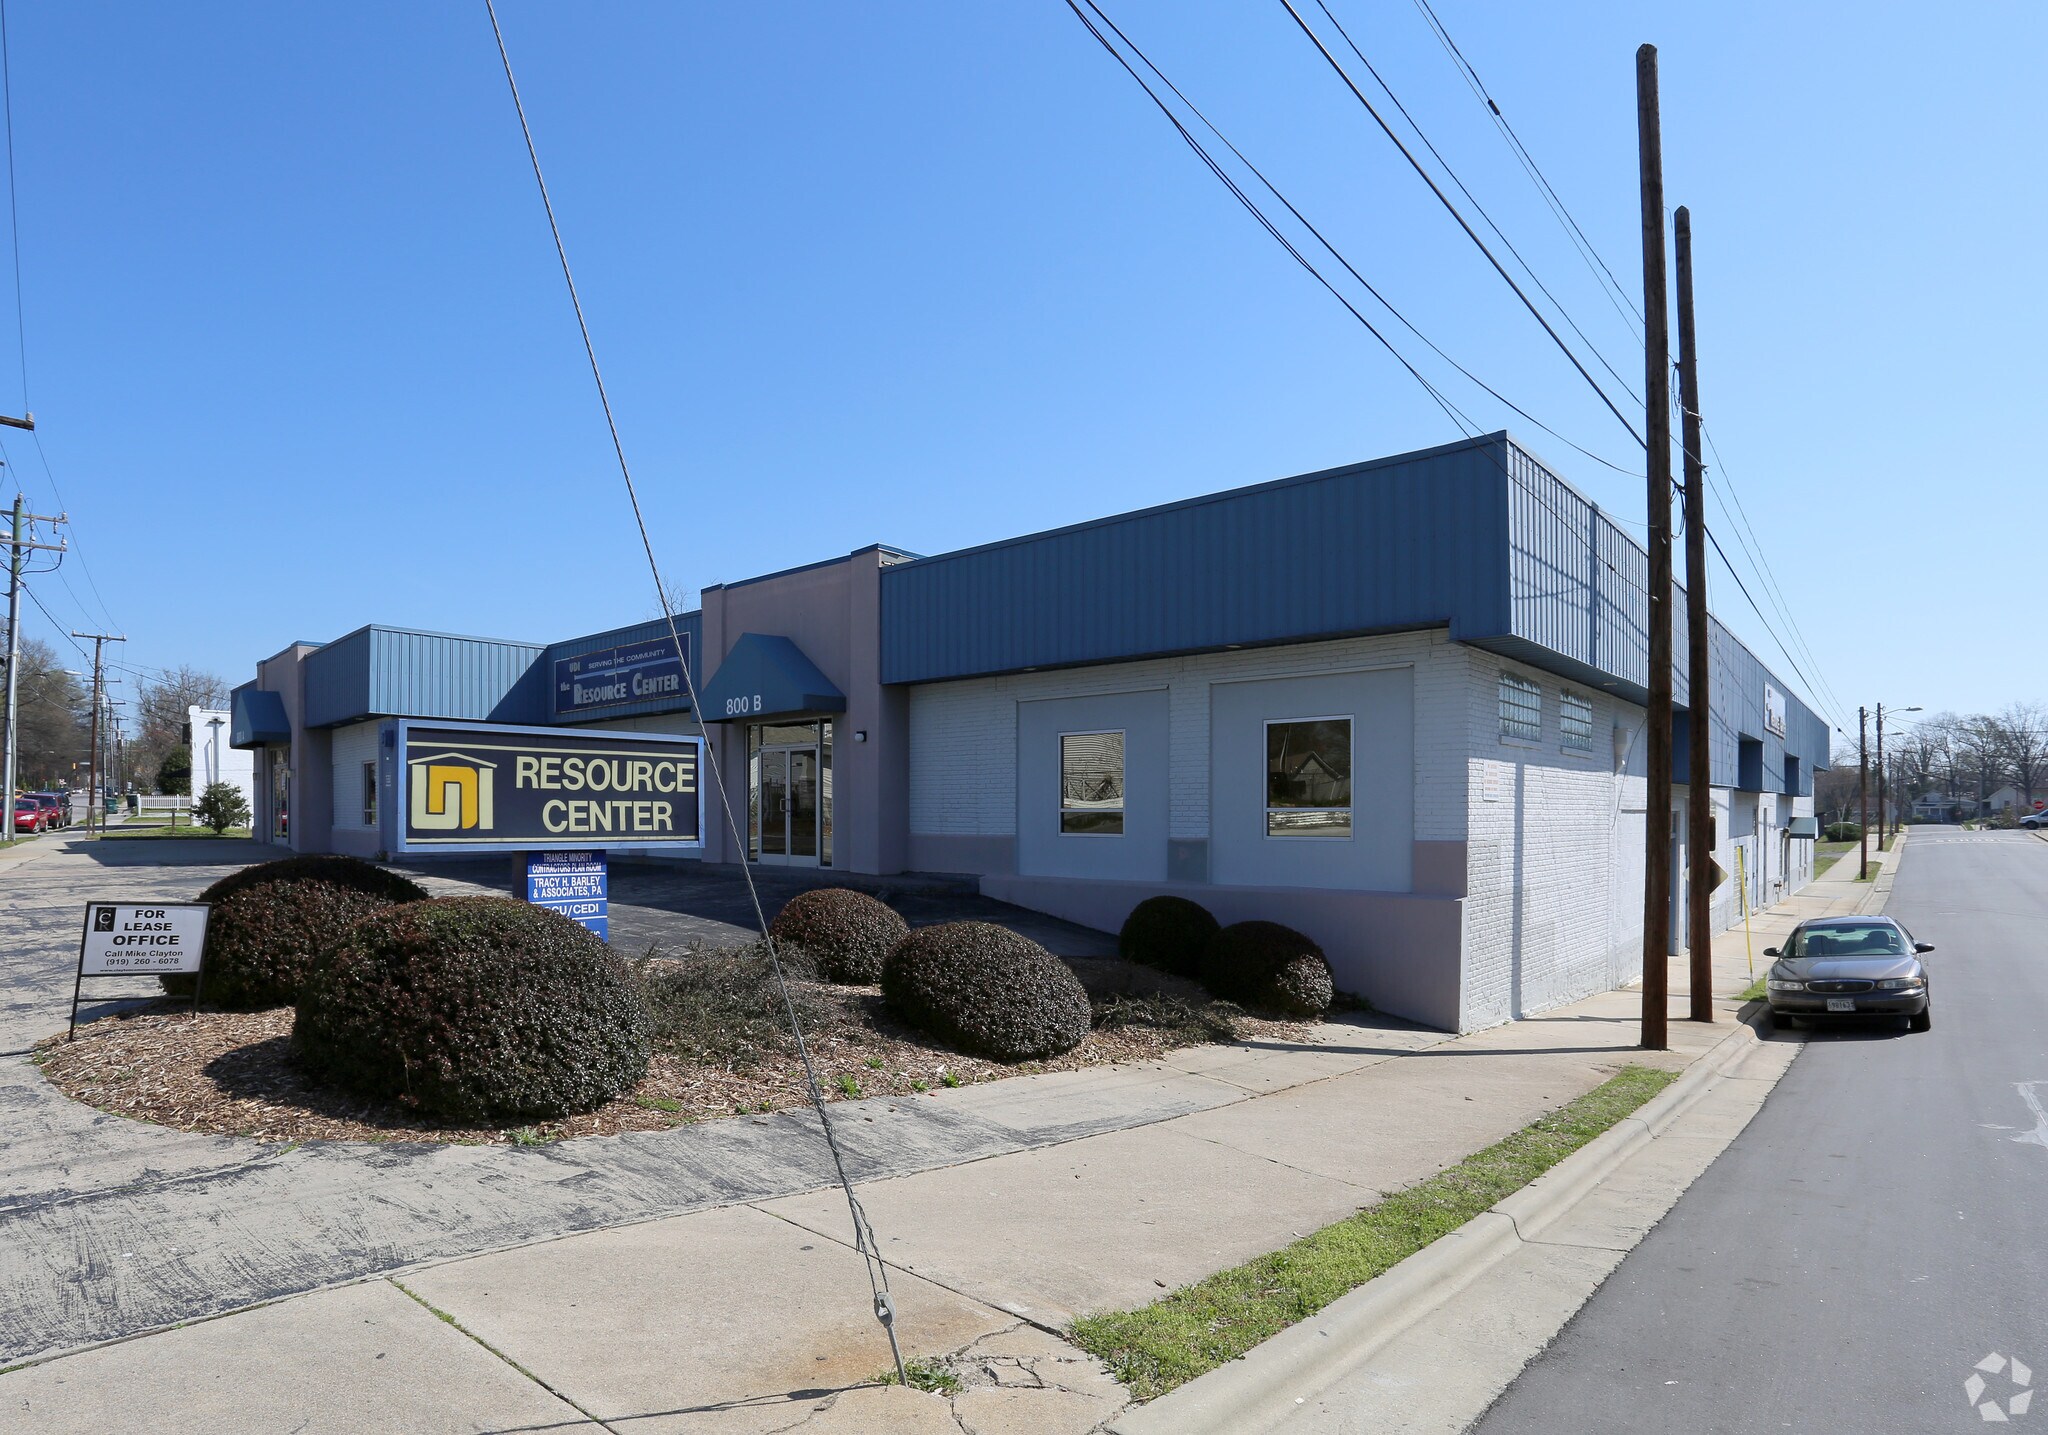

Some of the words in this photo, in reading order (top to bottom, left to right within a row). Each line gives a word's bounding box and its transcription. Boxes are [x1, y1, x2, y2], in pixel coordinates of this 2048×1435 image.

[588, 659, 612, 669] SERVING
[613, 656, 625, 664] THE
[626, 649, 666, 662] COMMUNITY
[560, 681, 571, 692] the
[726, 695, 749, 715] 800
[753, 694, 762, 712] B
[516, 755, 696, 793] RESOURCE
[542, 799, 673, 833] CENTER
[544, 854, 567, 862] TRIANGLE
[532, 864, 570, 873] CONTRACTORS
[572, 864, 585, 872] PLAN
[586, 862, 601, 871] ROOM
[534, 878, 559, 887] TRACY
[562, 876, 569, 886] H.
[572, 876, 600, 886] BARLEY
[532, 888, 538, 898] &
[542, 886, 589, 897] ASSOCIATES,
[592, 886, 602, 895] PA
[134, 910, 165, 918] FOR
[112, 936, 179, 945] OFFICE
